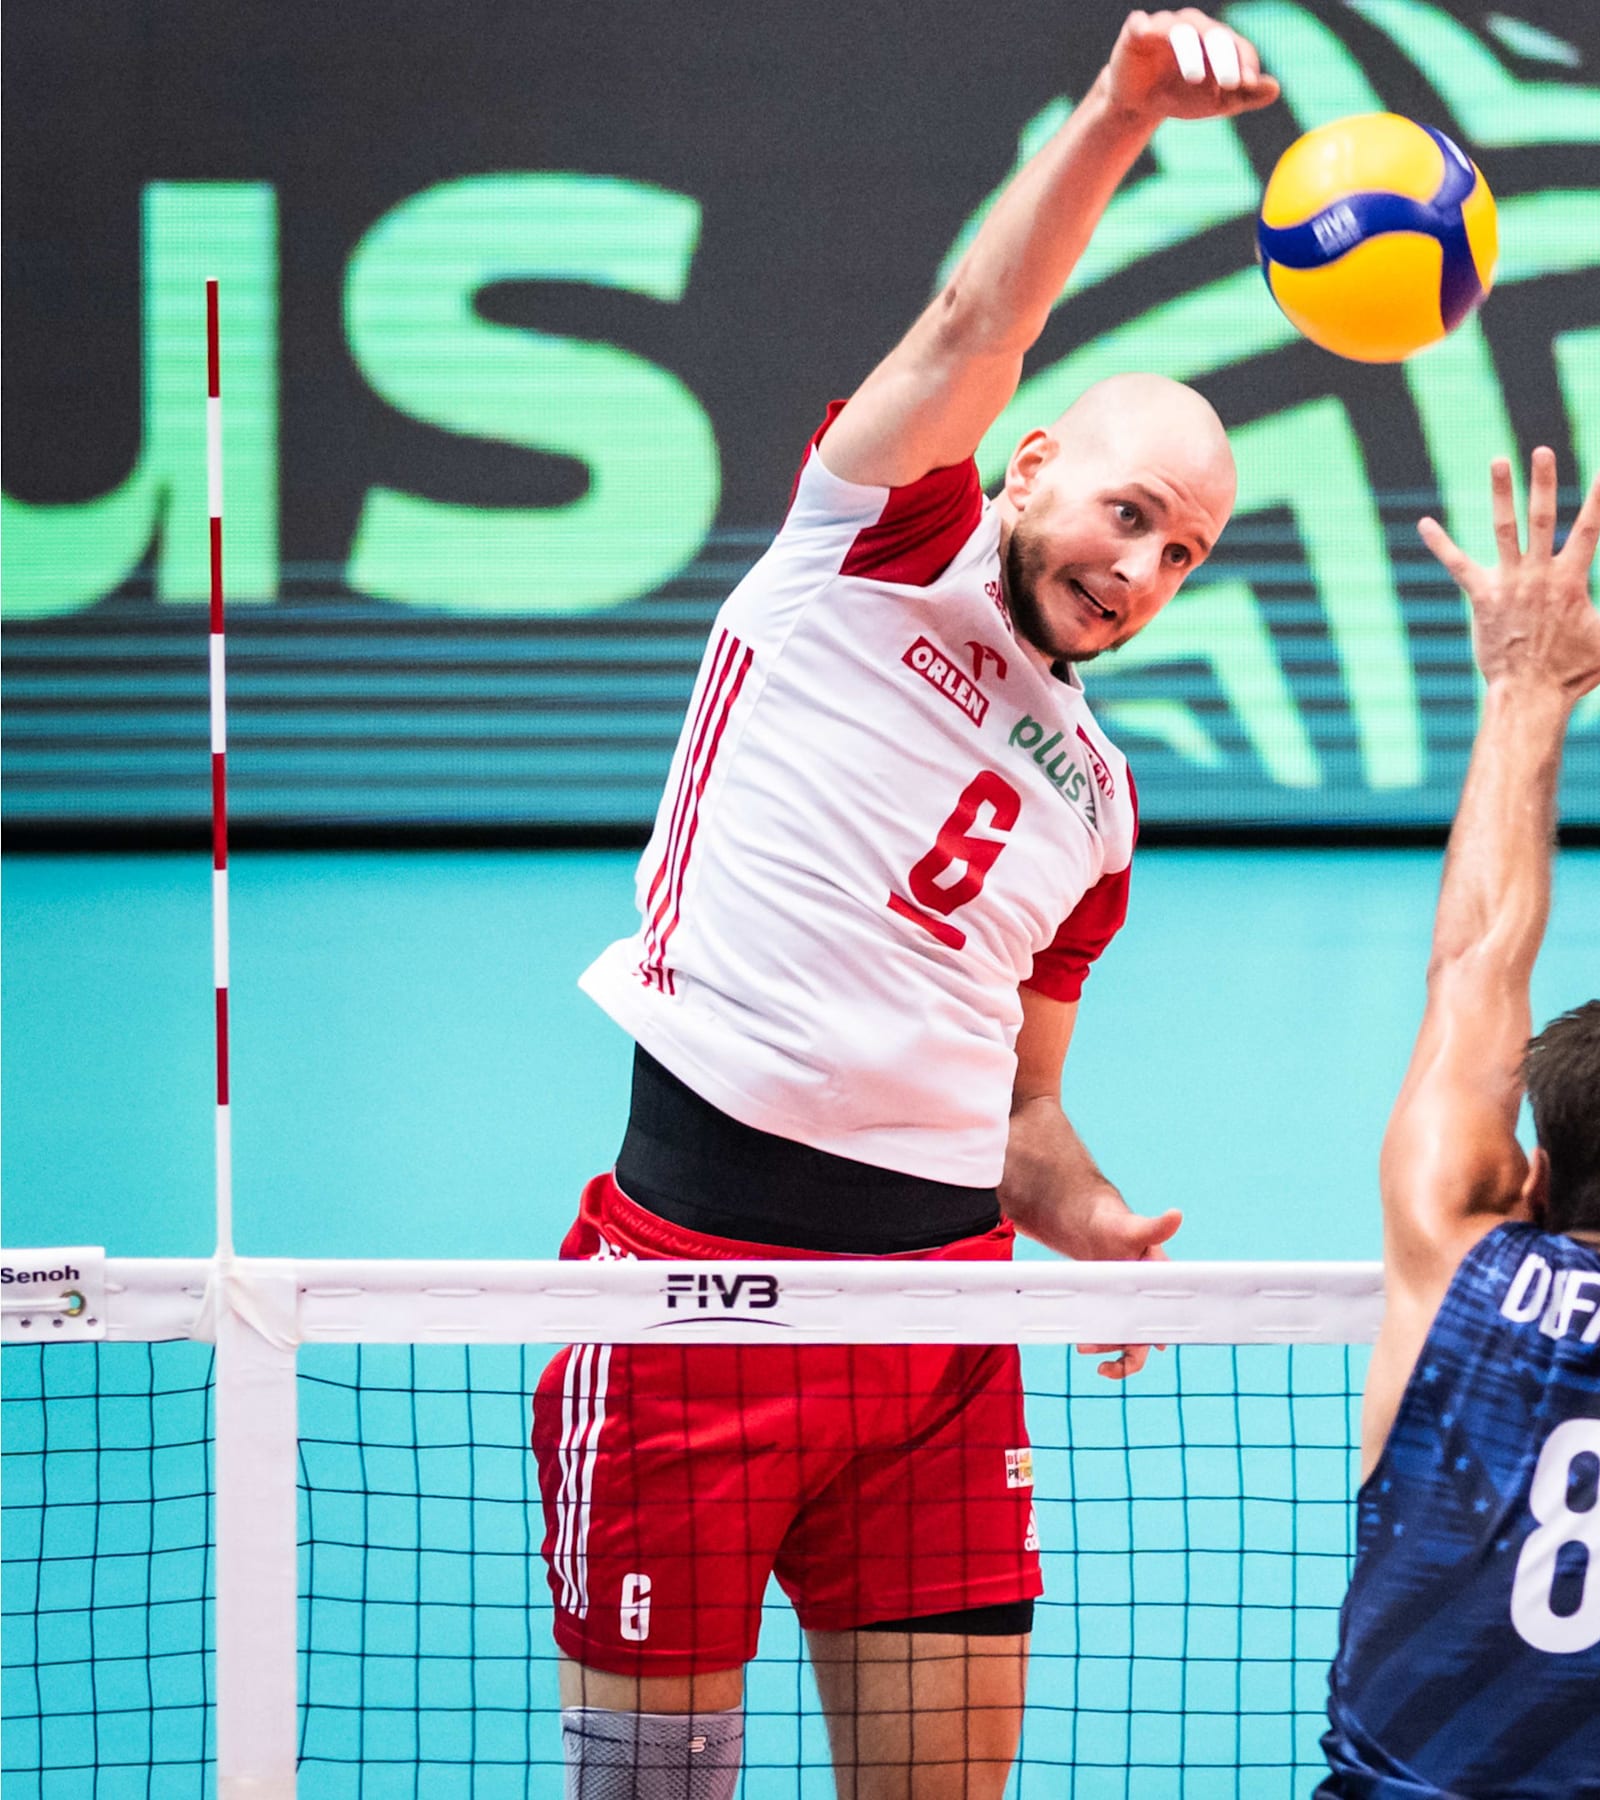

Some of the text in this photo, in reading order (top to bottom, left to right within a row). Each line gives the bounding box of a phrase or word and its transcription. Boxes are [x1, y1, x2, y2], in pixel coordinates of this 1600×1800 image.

[911, 645, 985, 721] ORLEN
[1008, 714, 1087, 802] plus
[908, 770, 1021, 917] 6
[0, 1265, 80, 1284] Senoh
[667, 1274, 779, 1309] FIVB
[619, 1572, 652, 1642] 6
